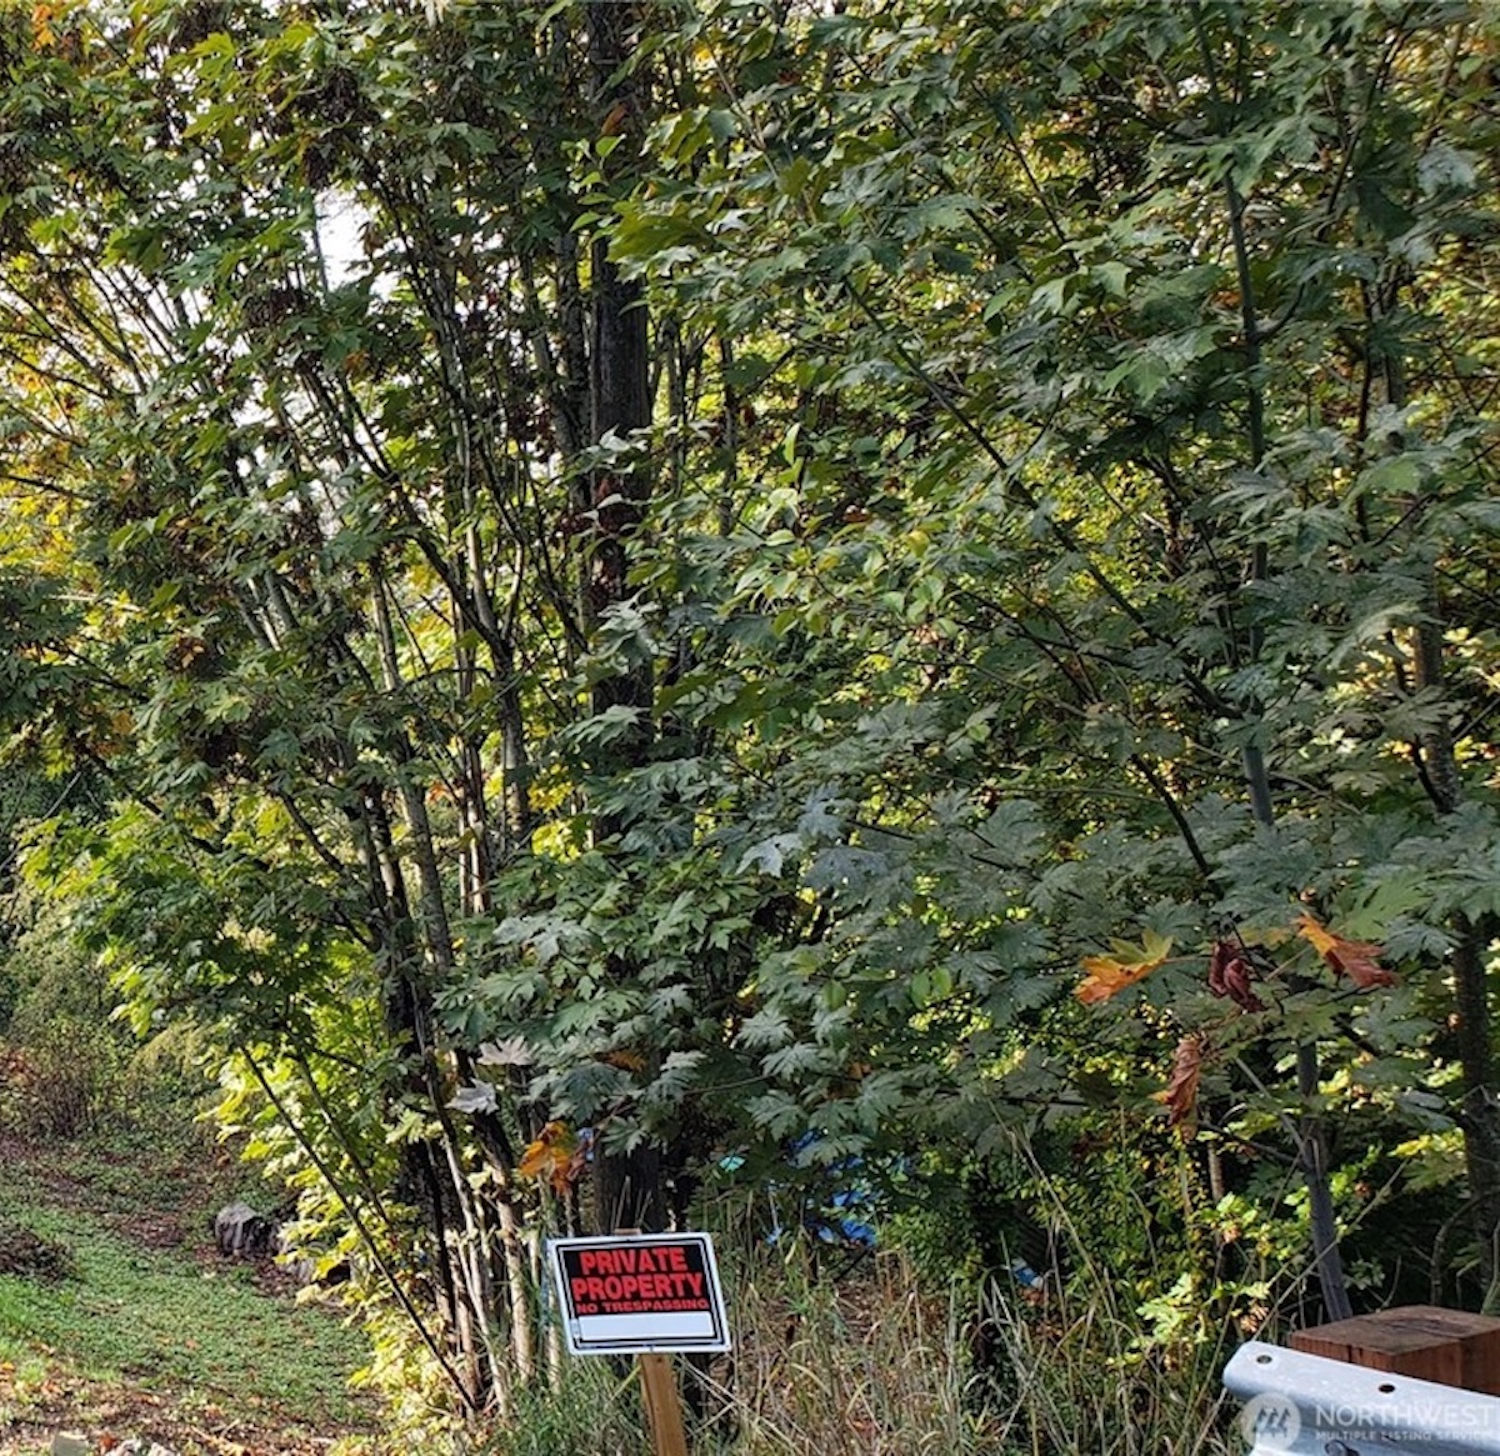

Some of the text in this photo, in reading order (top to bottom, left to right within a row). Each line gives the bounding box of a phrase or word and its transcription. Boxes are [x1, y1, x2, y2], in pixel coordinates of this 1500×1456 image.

[579, 1247, 688, 1275] PRIVATE
[571, 1273, 703, 1301] PROPERTY
[576, 1299, 709, 1314] NO TRESPASSING
